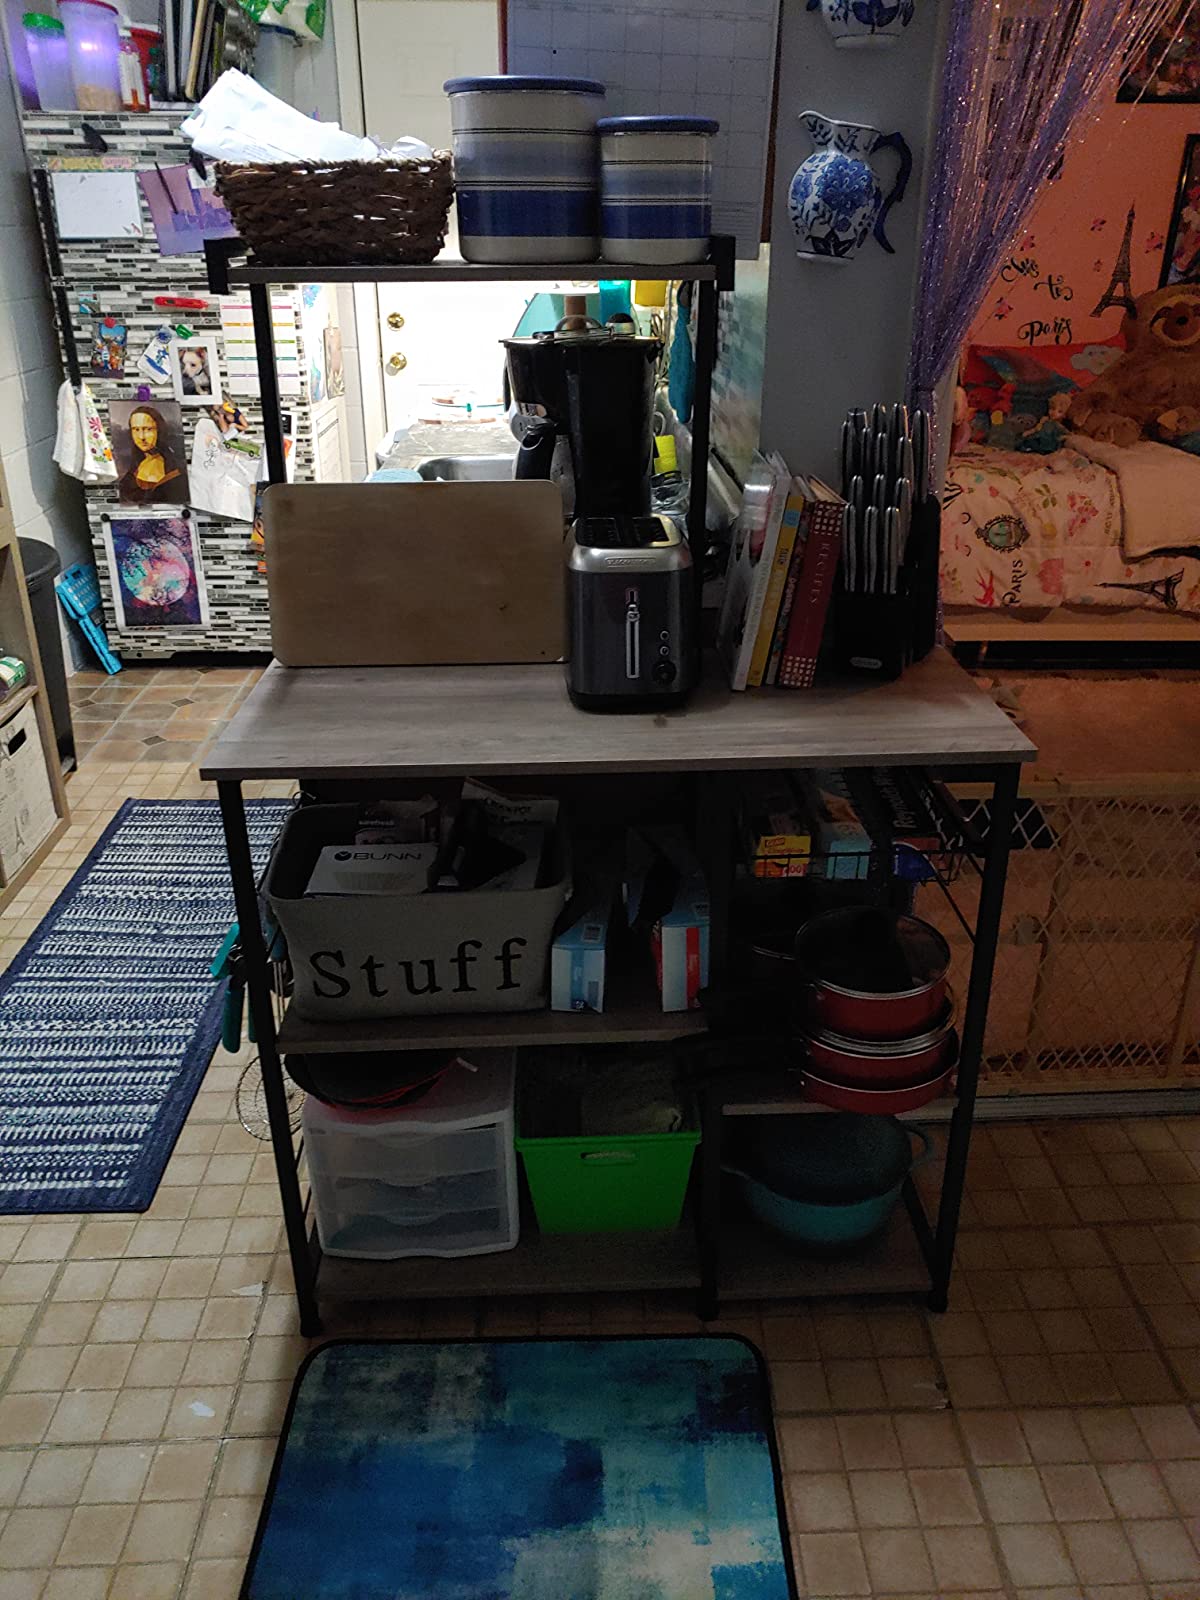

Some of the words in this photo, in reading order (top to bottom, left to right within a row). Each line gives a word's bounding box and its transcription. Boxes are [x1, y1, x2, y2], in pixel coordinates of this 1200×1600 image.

[1002, 559, 1027, 607] PARIS
[353, 852, 421, 861] BUNN
[310, 937, 527, 998] Stuff
